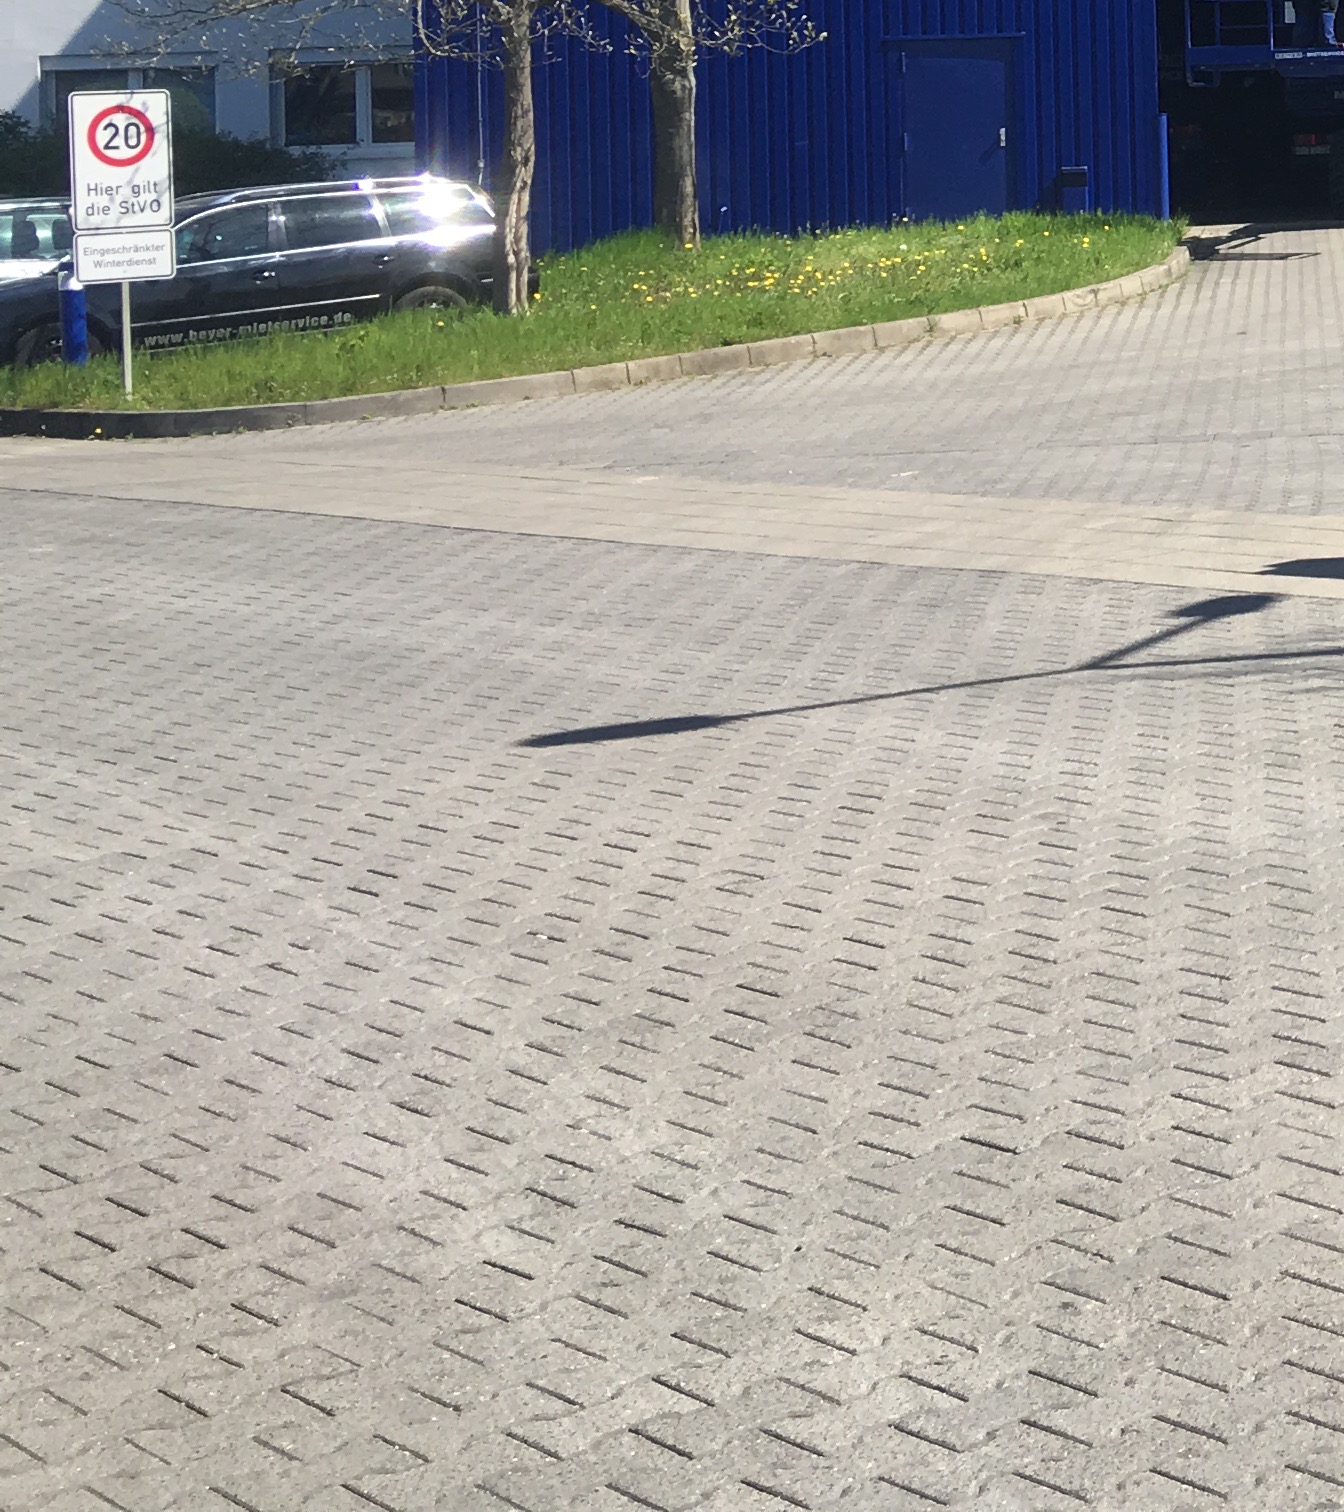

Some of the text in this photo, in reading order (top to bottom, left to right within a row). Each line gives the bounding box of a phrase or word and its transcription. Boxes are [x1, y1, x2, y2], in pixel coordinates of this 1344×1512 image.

[102, 122, 142, 150] 20
[87, 180, 159, 198] Hier gilt
[86, 199, 161, 216] die StVO
[83, 244, 165, 257] Eingeschränkter
[93, 257, 157, 268] Winterdienst
